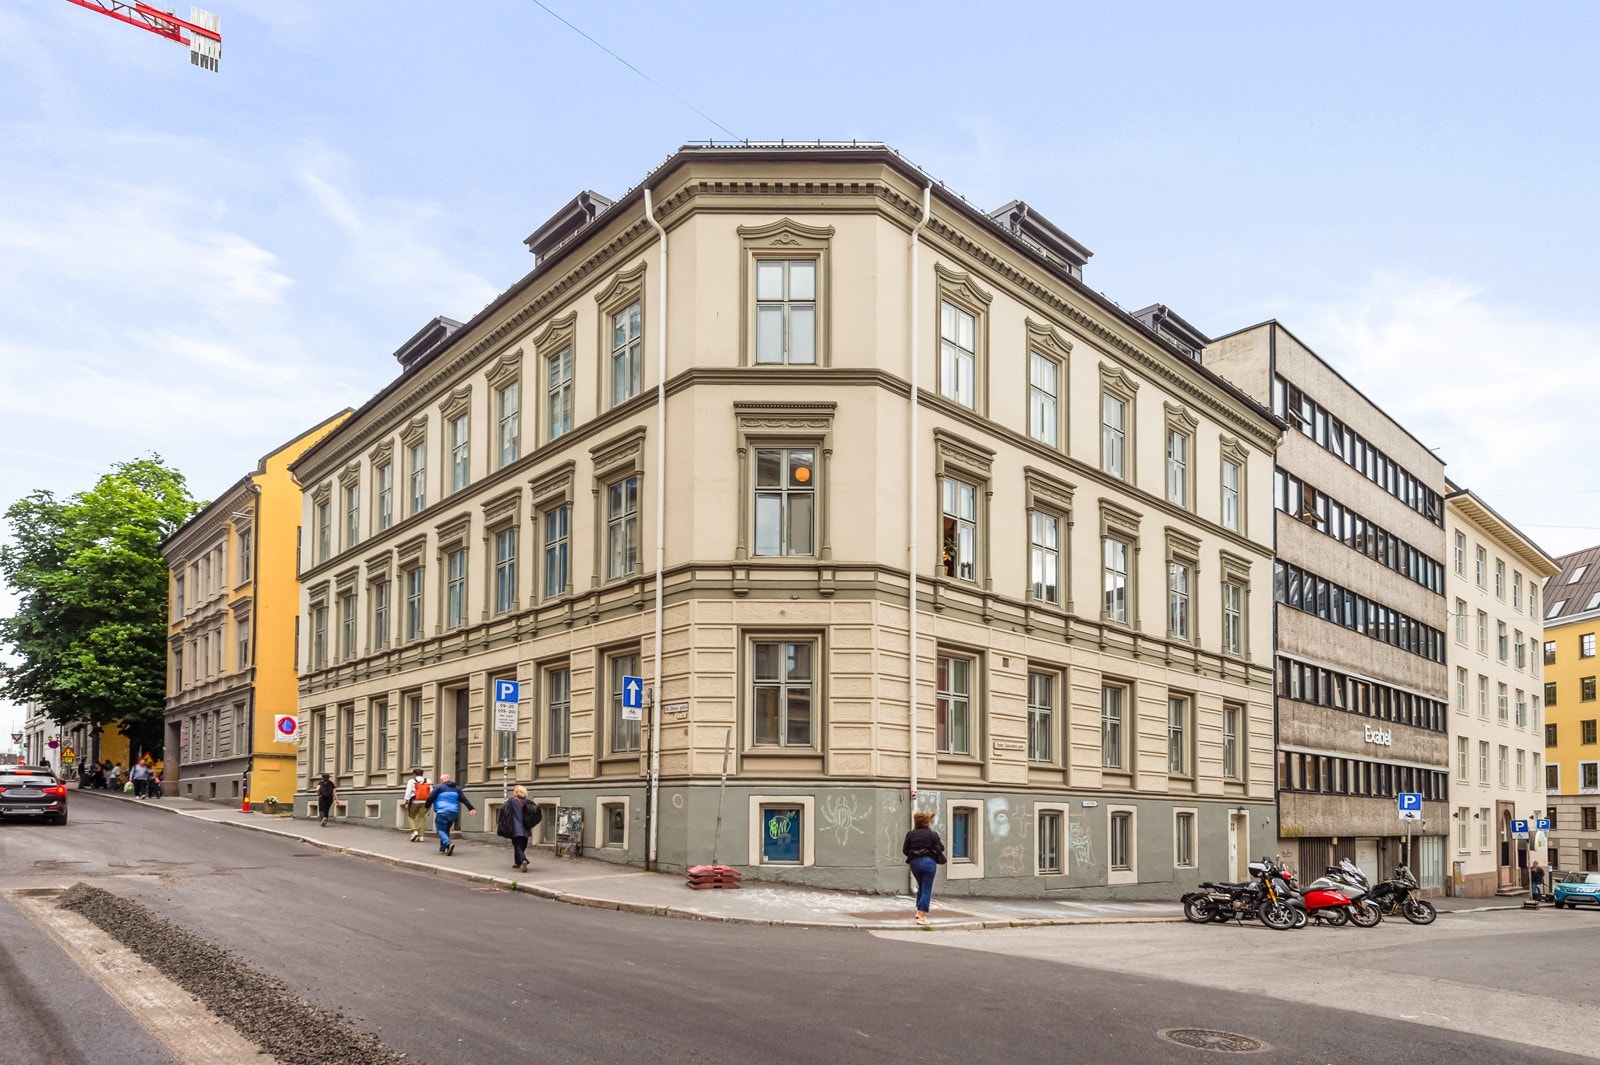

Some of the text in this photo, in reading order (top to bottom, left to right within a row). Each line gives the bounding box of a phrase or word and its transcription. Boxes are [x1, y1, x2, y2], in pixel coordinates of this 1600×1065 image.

[501, 683, 514, 699] P
[1364, 723, 1391, 746] Exabel
[1404, 795, 1416, 808] P
[1515, 821, 1525, 832] P
[1539, 820, 1547, 829] P
